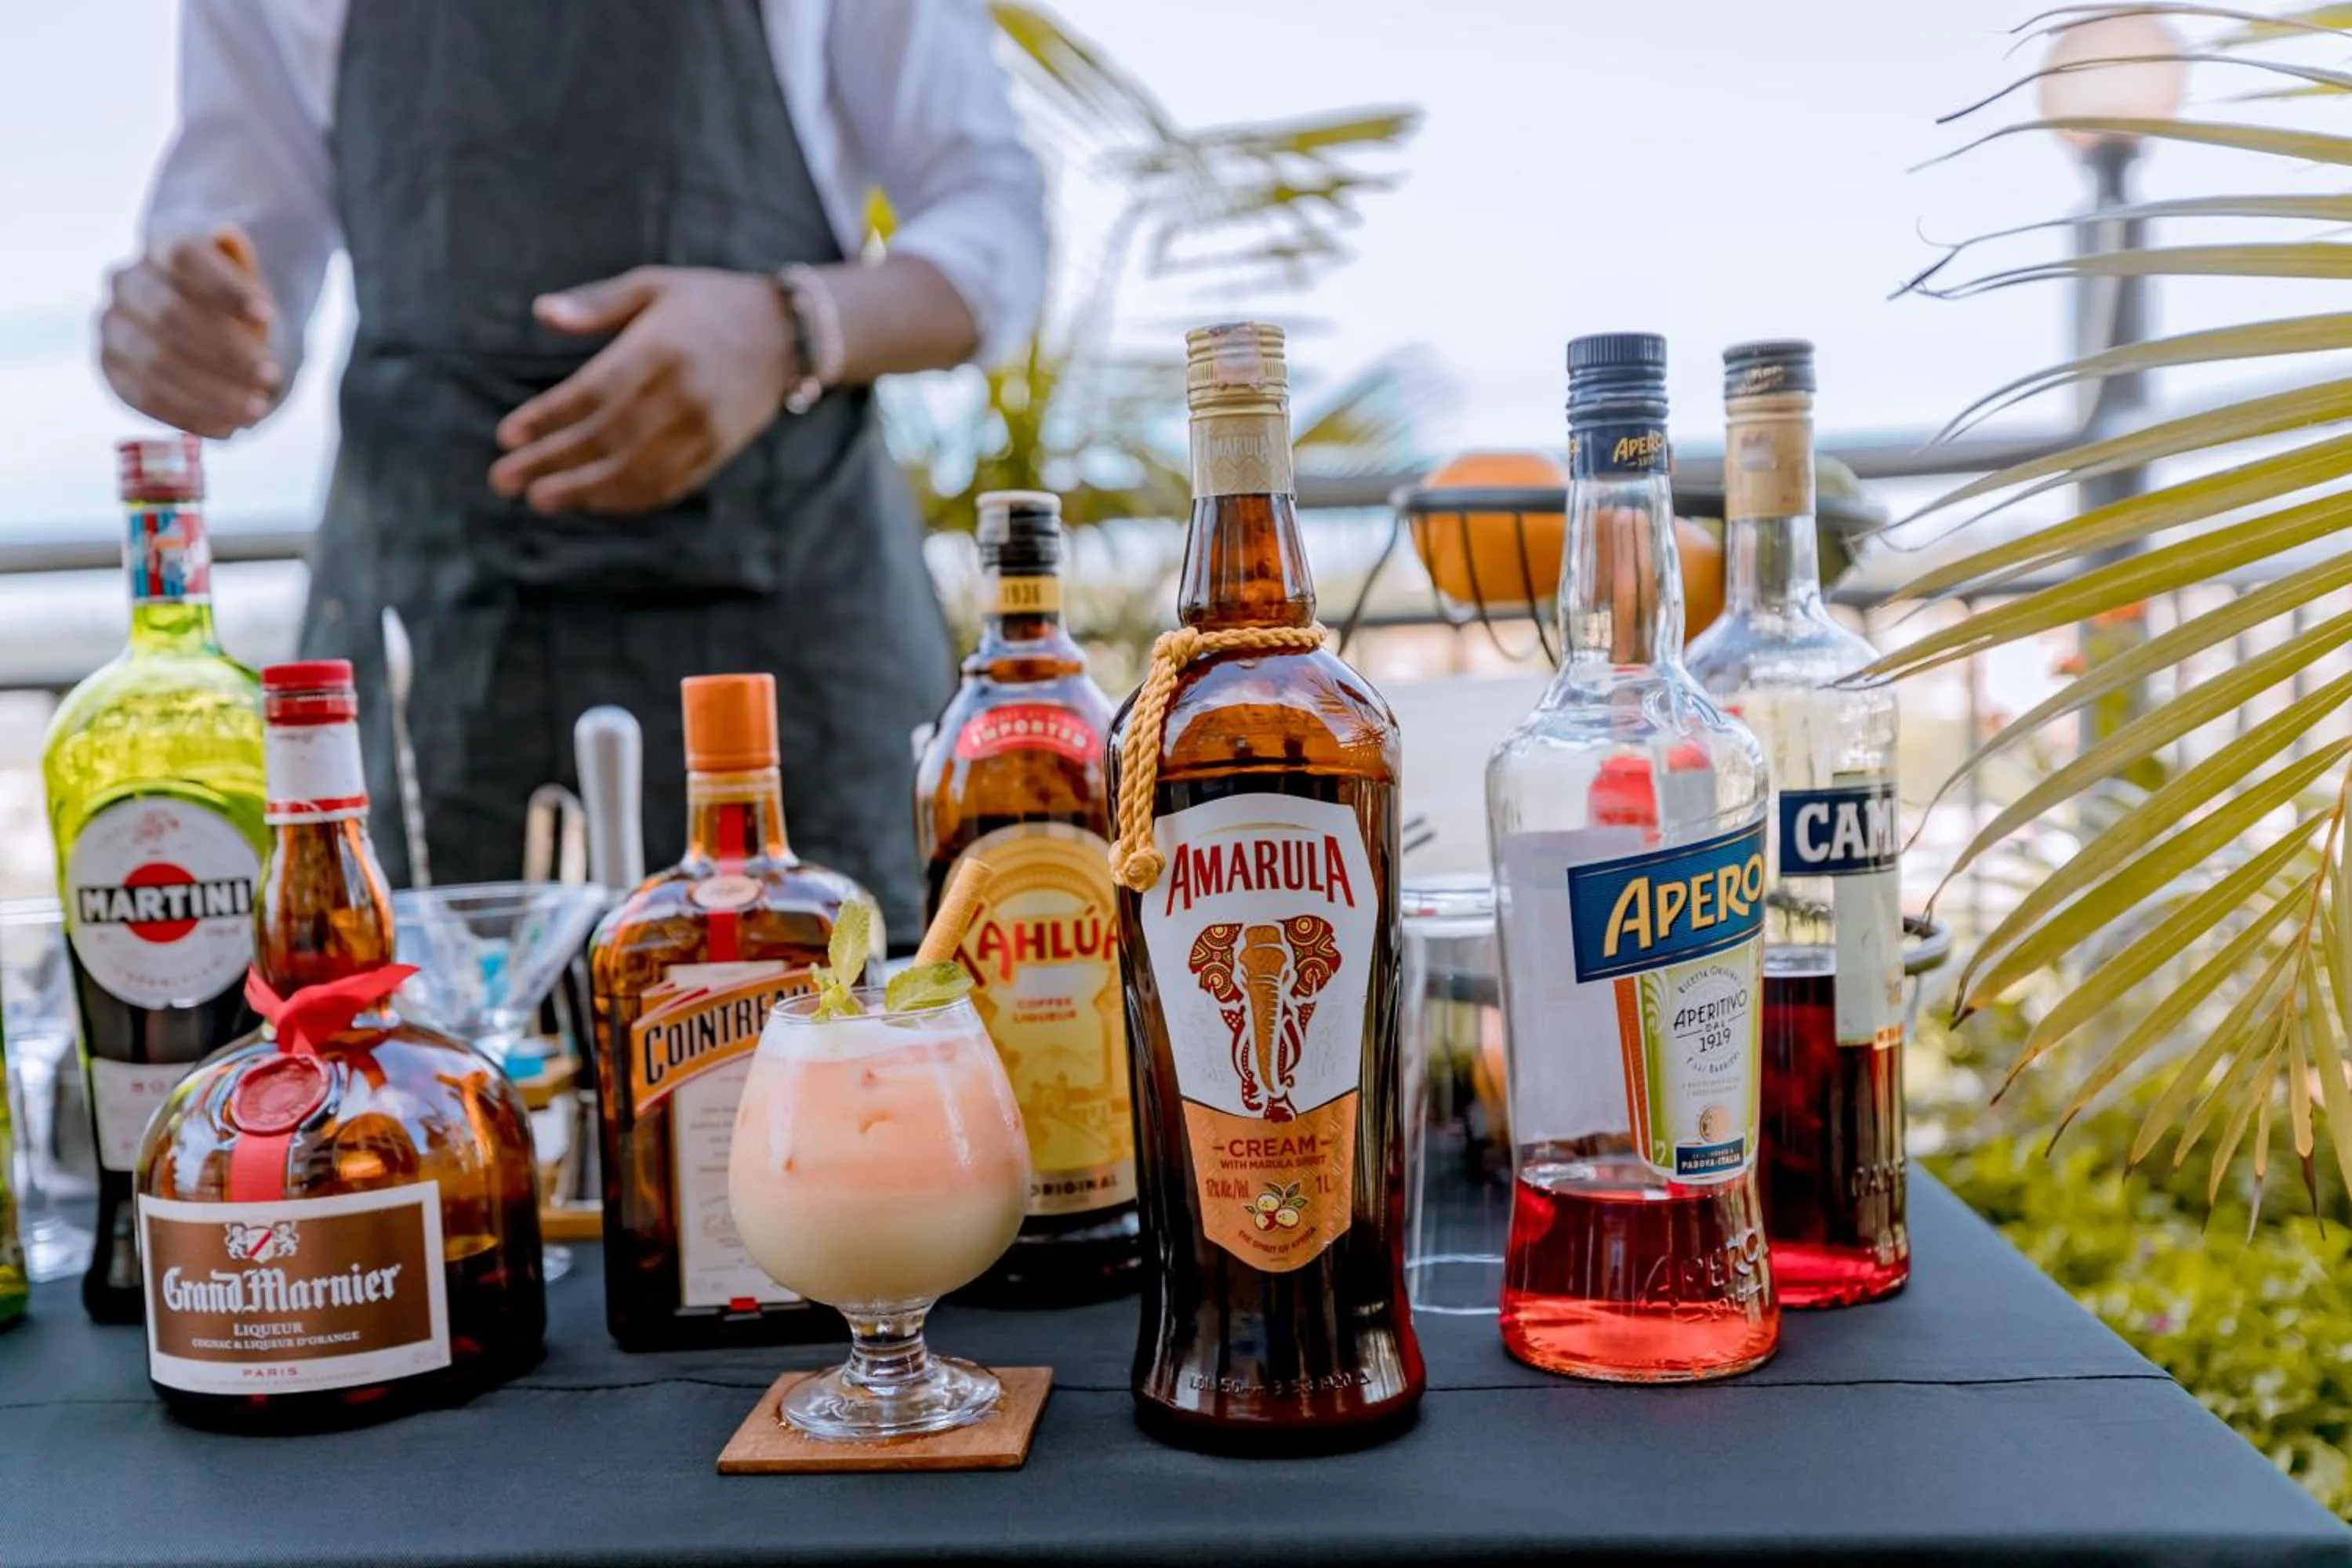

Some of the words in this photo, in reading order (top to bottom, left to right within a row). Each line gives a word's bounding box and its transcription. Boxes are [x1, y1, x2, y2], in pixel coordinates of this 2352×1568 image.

[1004, 583, 1040, 604] 1936
[969, 719, 1087, 748] IMPORTED
[1166, 834, 1356, 916] AMARULA
[82, 880, 250, 922] MARTINI
[1603, 852, 1764, 957] APERO
[1673, 989, 1748, 1031] APERITIVO
[644, 985, 808, 1085] COINTRE
[1699, 1028, 1732, 1053] 1919
[1229, 1135, 1316, 1158] CREAM
[1221, 1159, 1247, 1170] WITH
[1249, 1158, 1296, 1170] MARULA
[1297, 1155, 1326, 1167] SPIRIT
[163, 1267, 243, 1313] Grand
[241, 1263, 402, 1313] Marnier
[192, 1338, 232, 1350] COGNAC
[245, 1337, 296, 1350] LIQUEUR
[297, 1330, 361, 1347] D'ORANGE
[234, 1323, 304, 1338] LIQUEUR
[243, 1367, 298, 1378] PARIS
